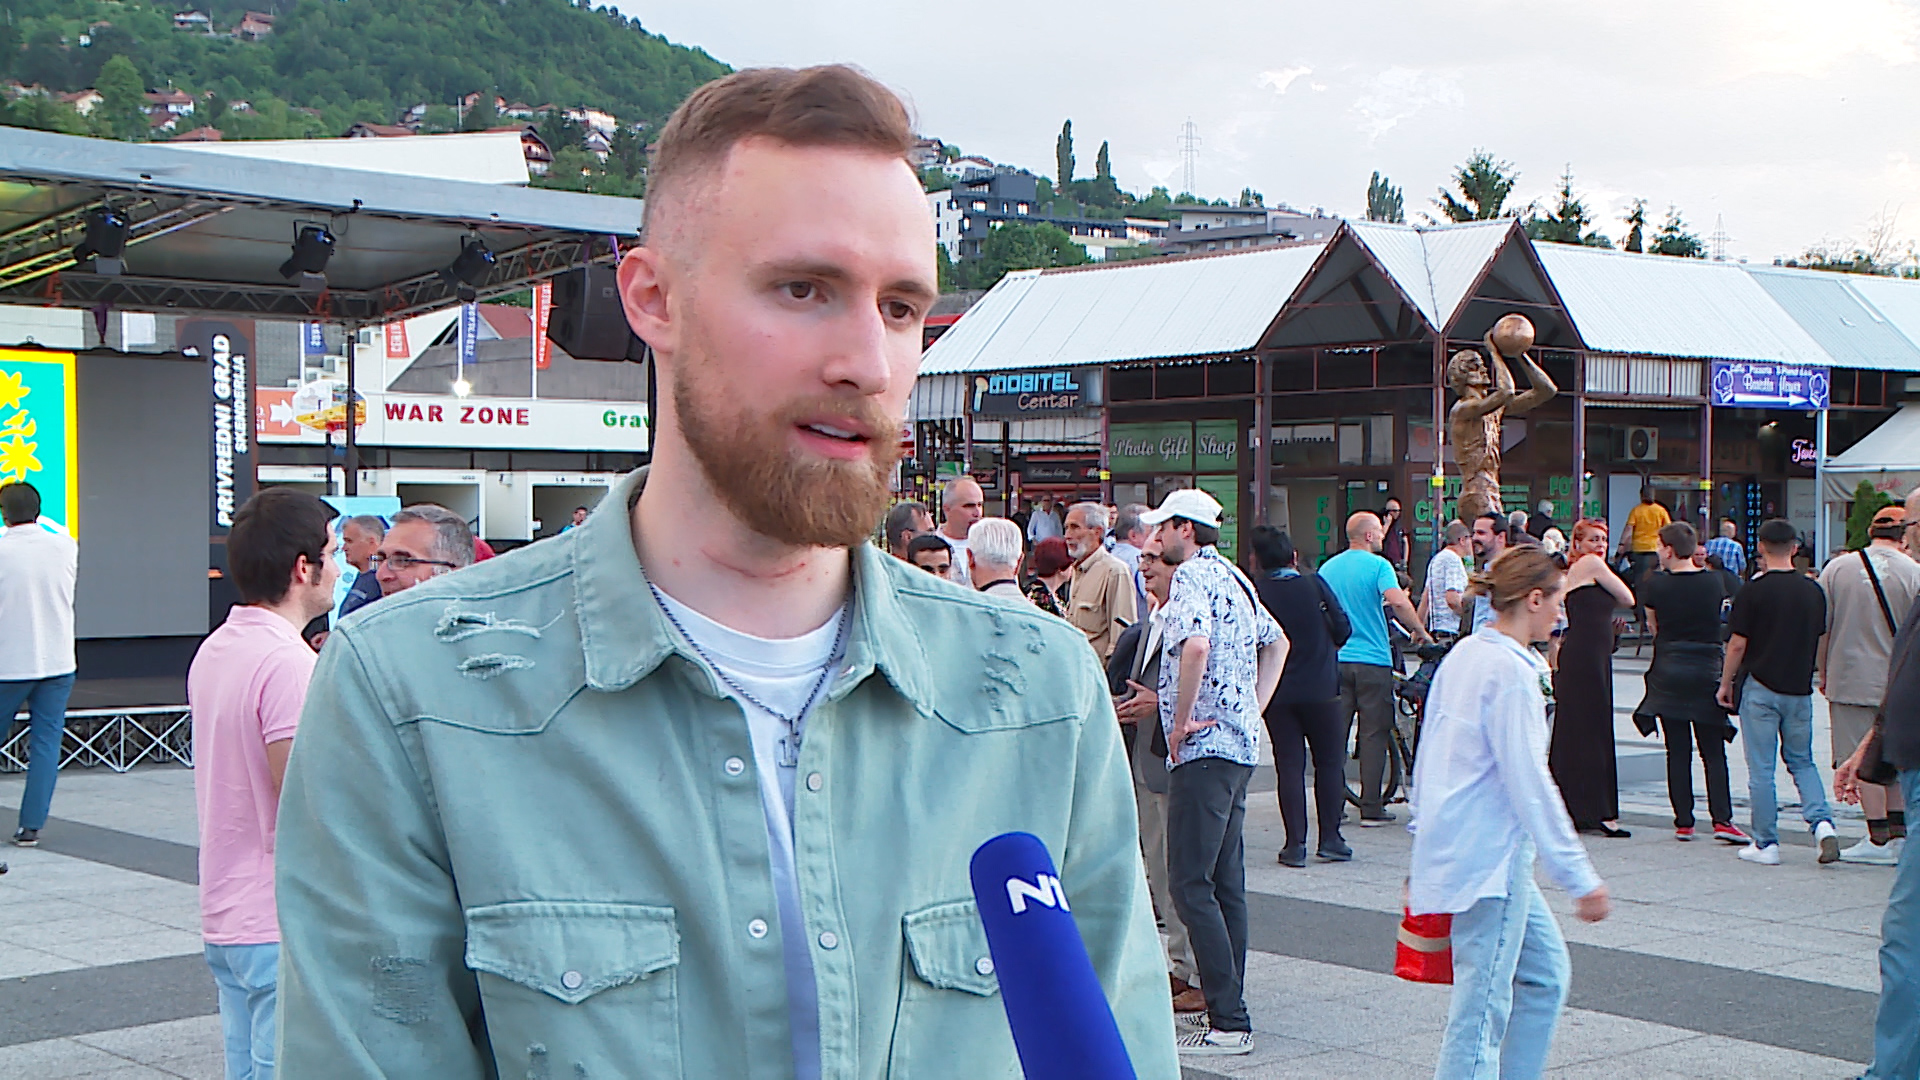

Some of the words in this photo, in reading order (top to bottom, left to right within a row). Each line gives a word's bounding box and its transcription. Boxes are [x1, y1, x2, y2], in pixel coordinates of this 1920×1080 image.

[212, 333, 232, 400] GRAD
[989, 372, 1079, 394] MOBITEL
[232, 354, 248, 454] SKENDERIJA
[1018, 392, 1079, 410] Centar
[384, 403, 444, 422] WAR
[459, 406, 530, 425] ZONE
[1112, 438, 1154, 456] Photo
[1159, 435, 1188, 460] Gift
[1198, 434, 1237, 460] Shop
[214, 402, 235, 527] PRIVREDNI
[1550, 476, 1592, 496] FOO
